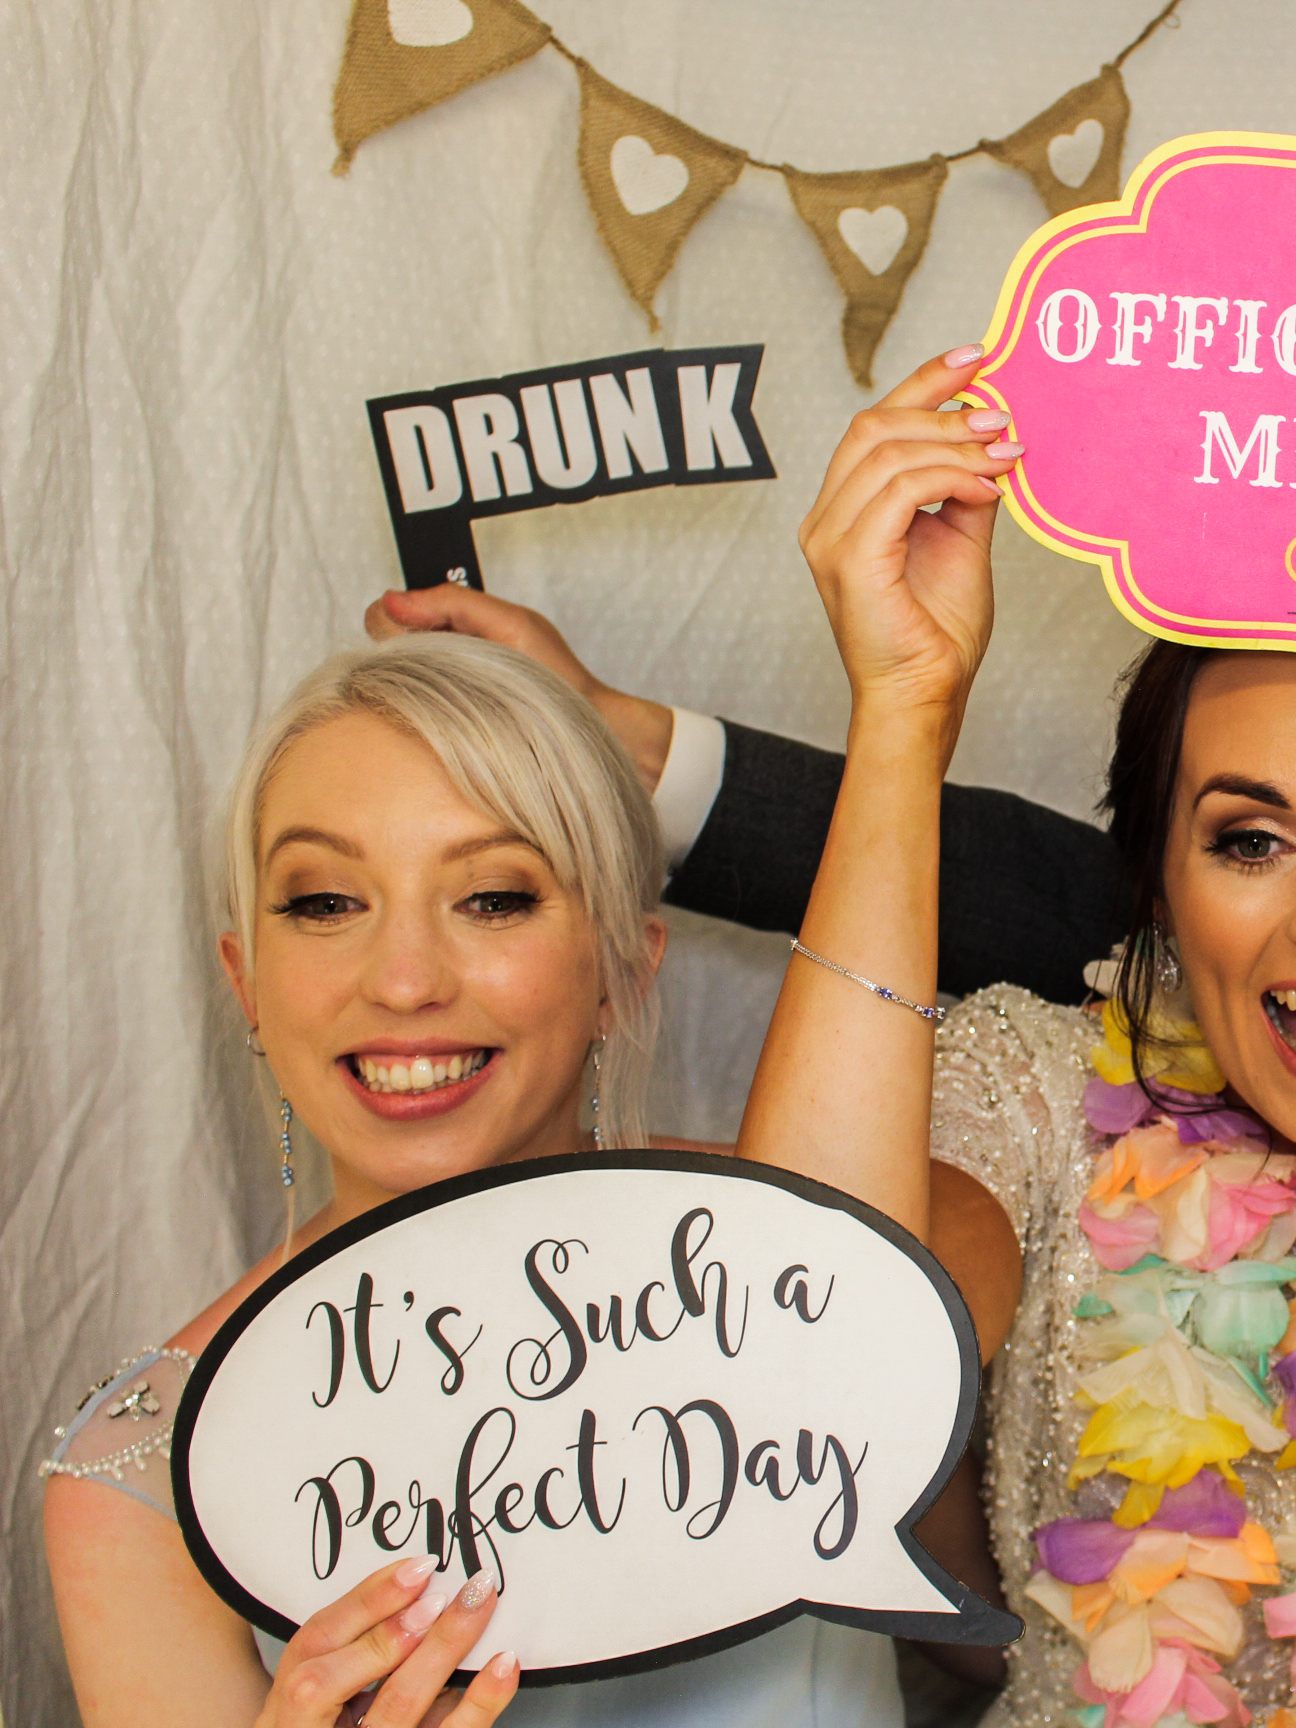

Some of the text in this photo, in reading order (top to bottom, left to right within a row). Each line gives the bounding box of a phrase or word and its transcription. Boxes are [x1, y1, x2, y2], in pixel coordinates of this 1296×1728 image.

[383, 363, 753, 514] DRUNK
[305, 1206, 836, 1409] It's Such a
[293, 1399, 869, 1598] Perfect Day
